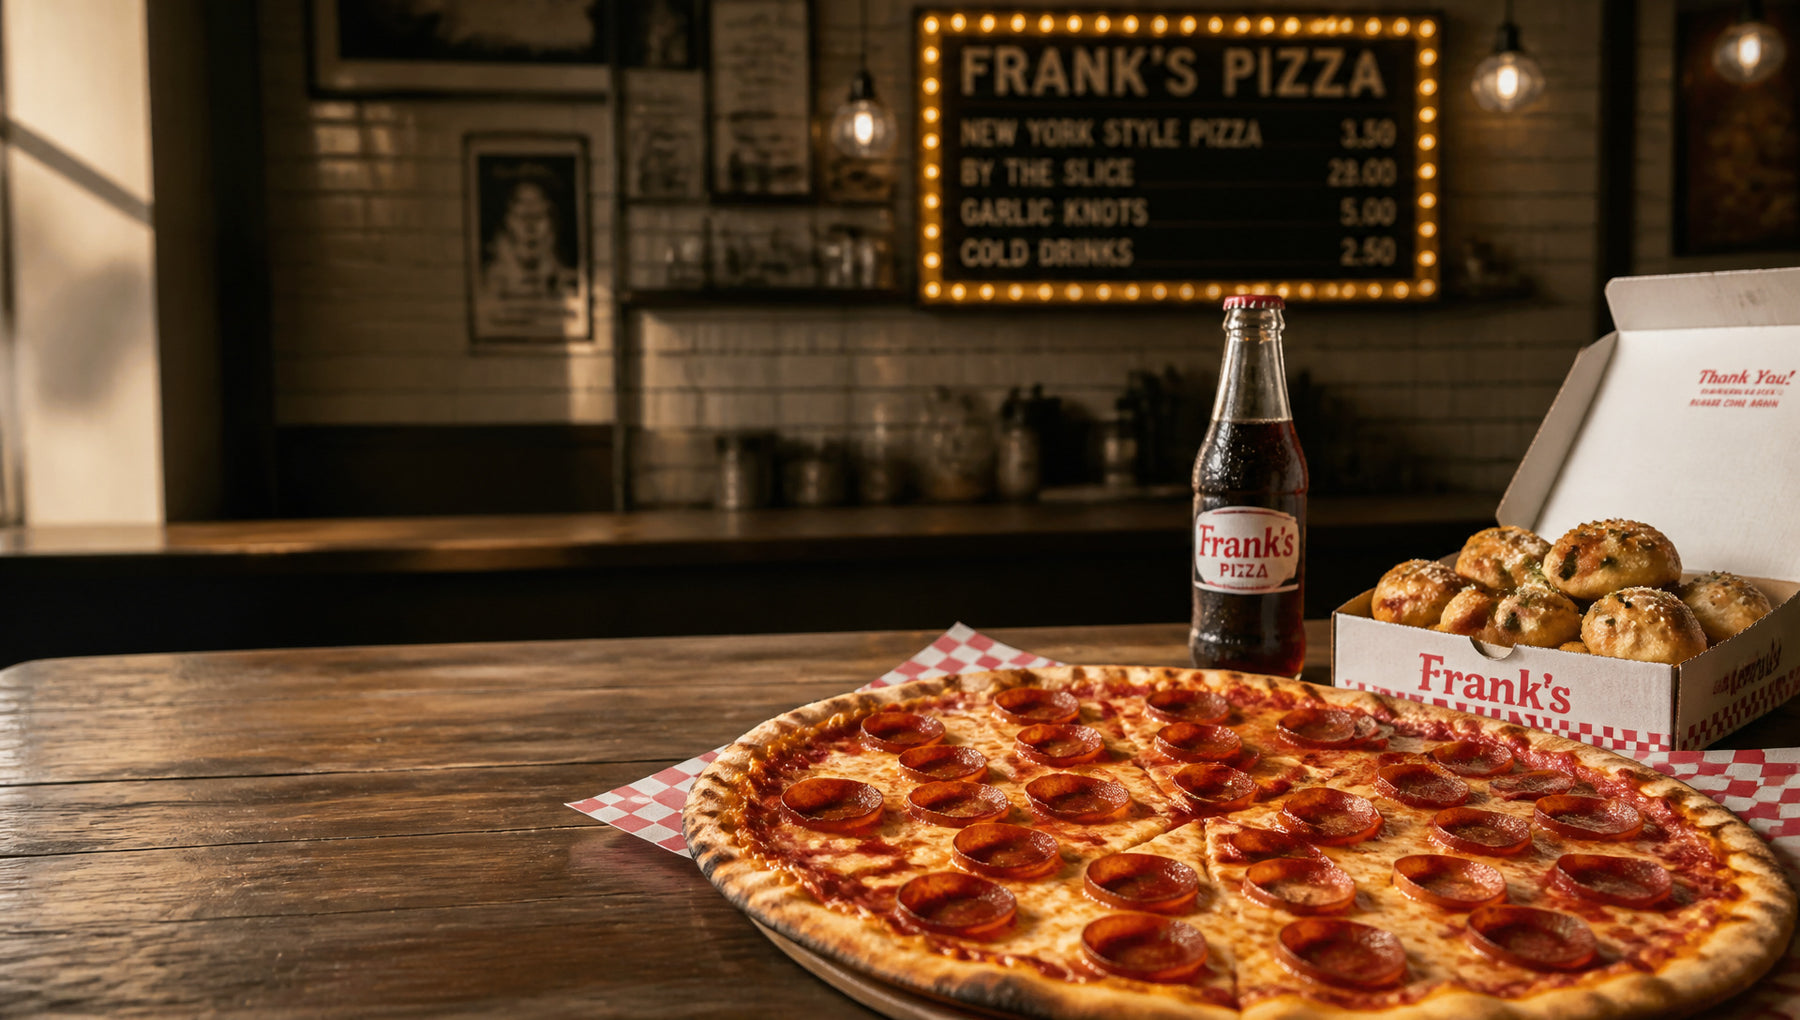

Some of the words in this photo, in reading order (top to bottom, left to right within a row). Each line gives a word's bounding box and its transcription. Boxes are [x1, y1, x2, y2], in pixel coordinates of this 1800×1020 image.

[961, 46, 1198, 96] FRANK'S
[1223, 47, 1386, 97] PIZZA
[960, 118, 1018, 147] NEW
[1026, 118, 1094, 147] YORK
[1103, 118, 1180, 148] STYLE
[1189, 118, 1262, 148] PIZZA
[960, 158, 995, 187] BY
[1004, 158, 1054, 187] THE
[1063, 158, 1135, 187] SLICE
[960, 198, 1054, 227] GARLIC
[1063, 198, 1149, 227] KNOTS
[1340, 197, 1397, 227] 5.00
[960, 238, 1030, 268] COLD
[1038, 238, 1135, 268] DRINKS
[1699, 369, 1750, 385] Thank
[1199, 524, 1294, 558] Frank's
[1220, 563, 1268, 578] PIZZA
[1418, 653, 1571, 714] Frank's
